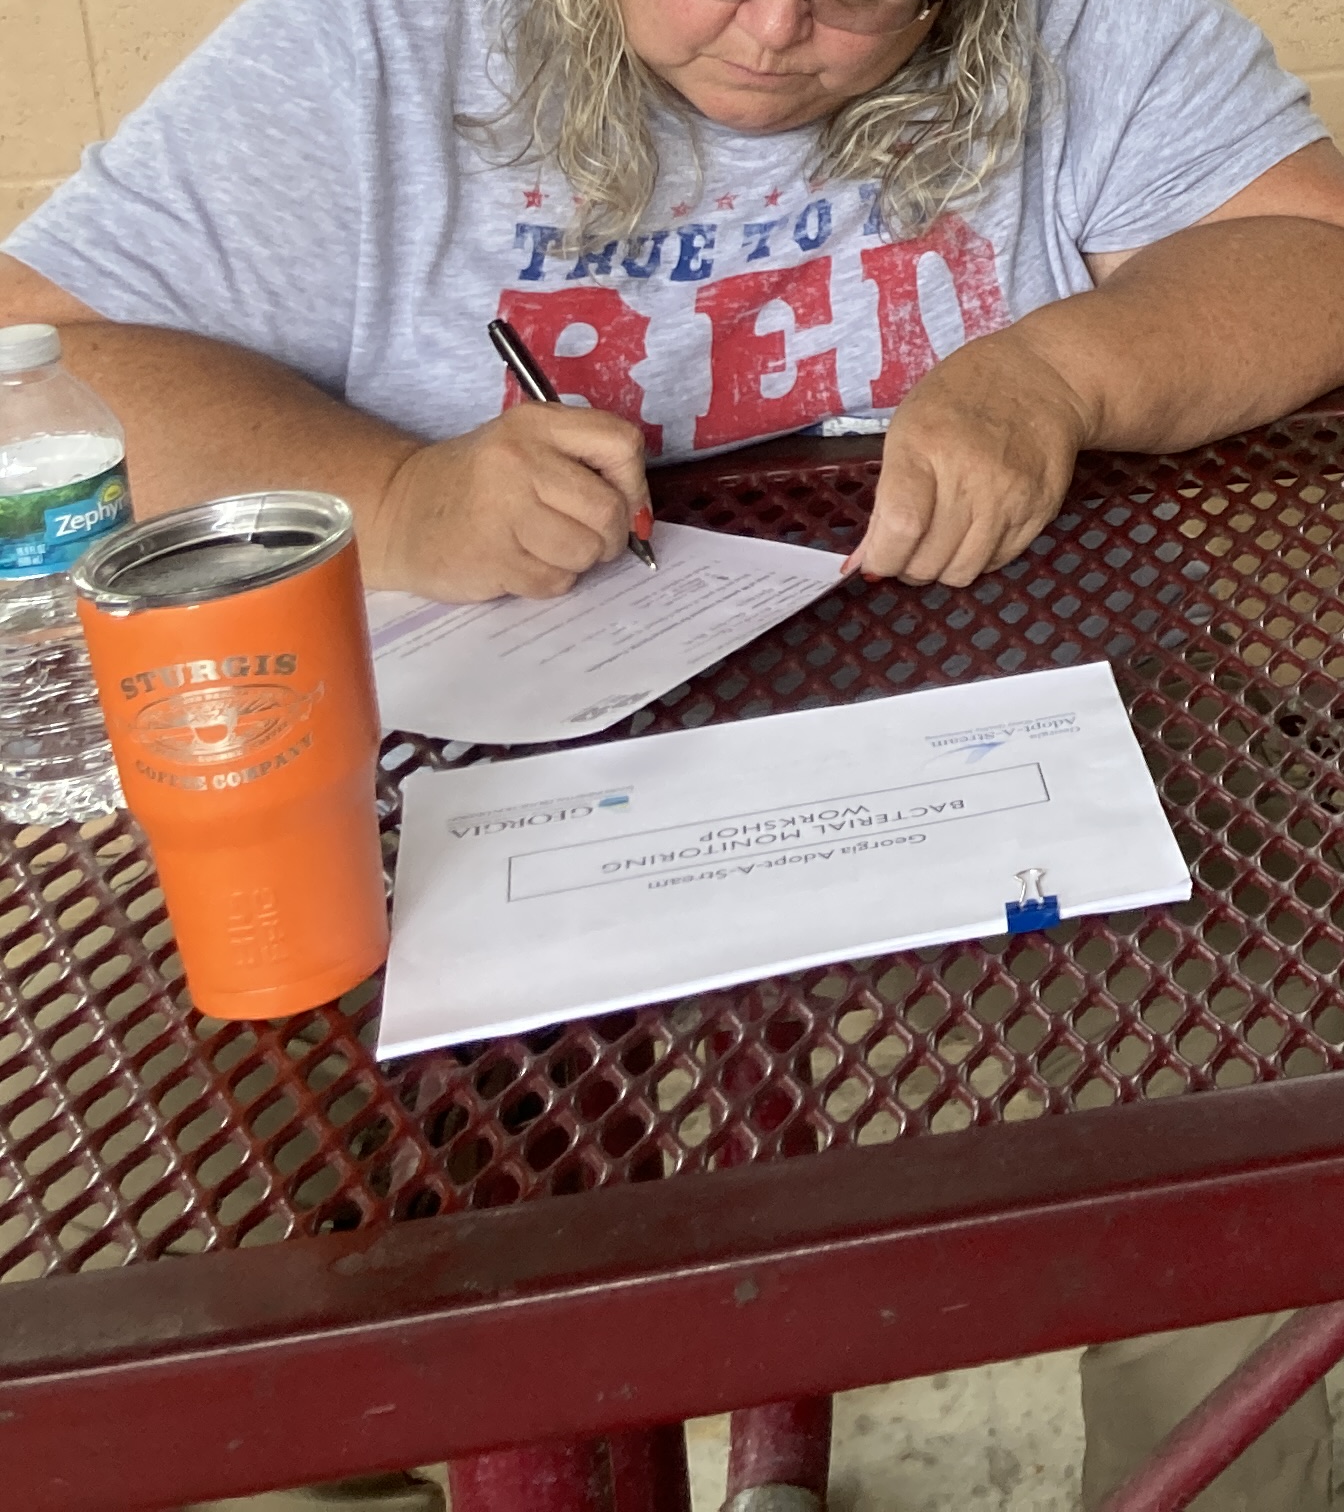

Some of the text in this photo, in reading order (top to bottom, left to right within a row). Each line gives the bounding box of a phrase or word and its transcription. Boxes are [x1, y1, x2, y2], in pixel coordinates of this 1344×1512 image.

[743, 198, 832, 262] TO
[499, 211, 1014, 455] RED
[120, 653, 298, 701] STURGIS
[931, 715, 1077, 748] Adopt-A-Stream
[135, 759, 208, 792] COFFEE
[212, 731, 314, 791] COMPANY
[450, 805, 594, 839] GEORGIA
[601, 798, 966, 873] BACTERIAL MONITORING
[699, 804, 870, 842] WORKSHOP
[648, 833, 926, 889] Georgia Adopt-A-Stream
